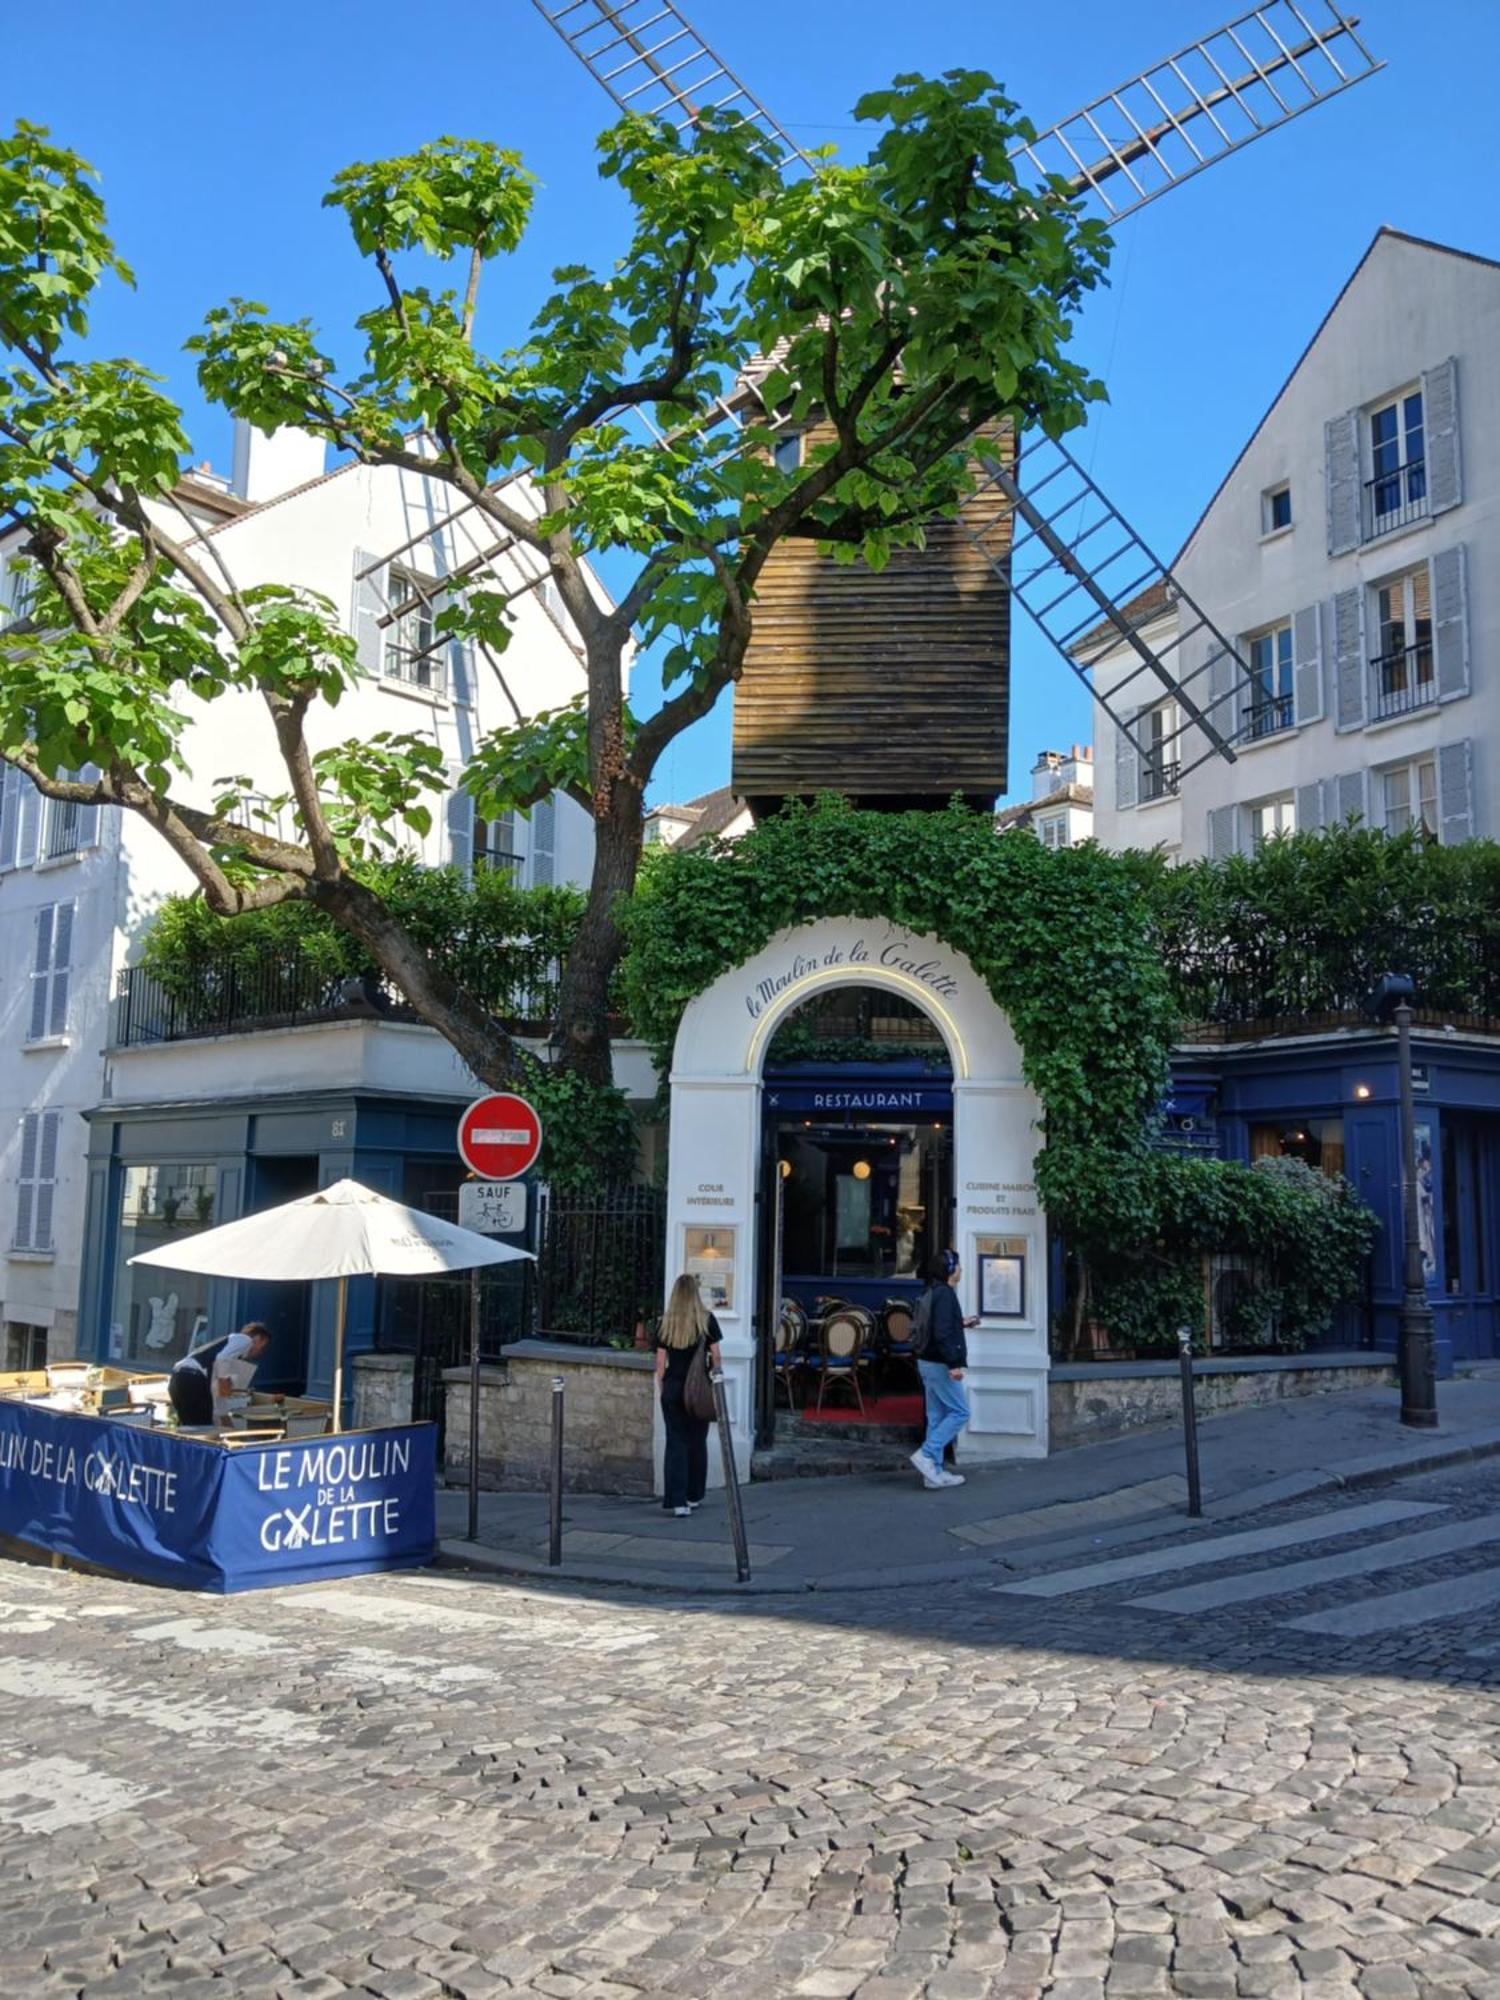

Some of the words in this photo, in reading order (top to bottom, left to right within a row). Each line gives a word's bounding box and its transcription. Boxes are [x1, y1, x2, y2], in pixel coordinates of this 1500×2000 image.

[746, 996, 762, 1019] le
[756, 955, 817, 1004] Moulin
[824, 946, 843, 965] de
[849, 939, 869, 962] la
[880, 942, 958, 1000] Galette
[814, 1092, 923, 1108] RESTAURANT
[477, 1187, 512, 1199] SAUF
[30, 1440, 53, 1479] DE
[56, 1446, 77, 1486] LA
[259, 1452, 292, 1491] LE
[298, 1438, 411, 1488] MOULIN
[317, 1488, 335, 1507] DE
[340, 1485, 356, 1503] LA
